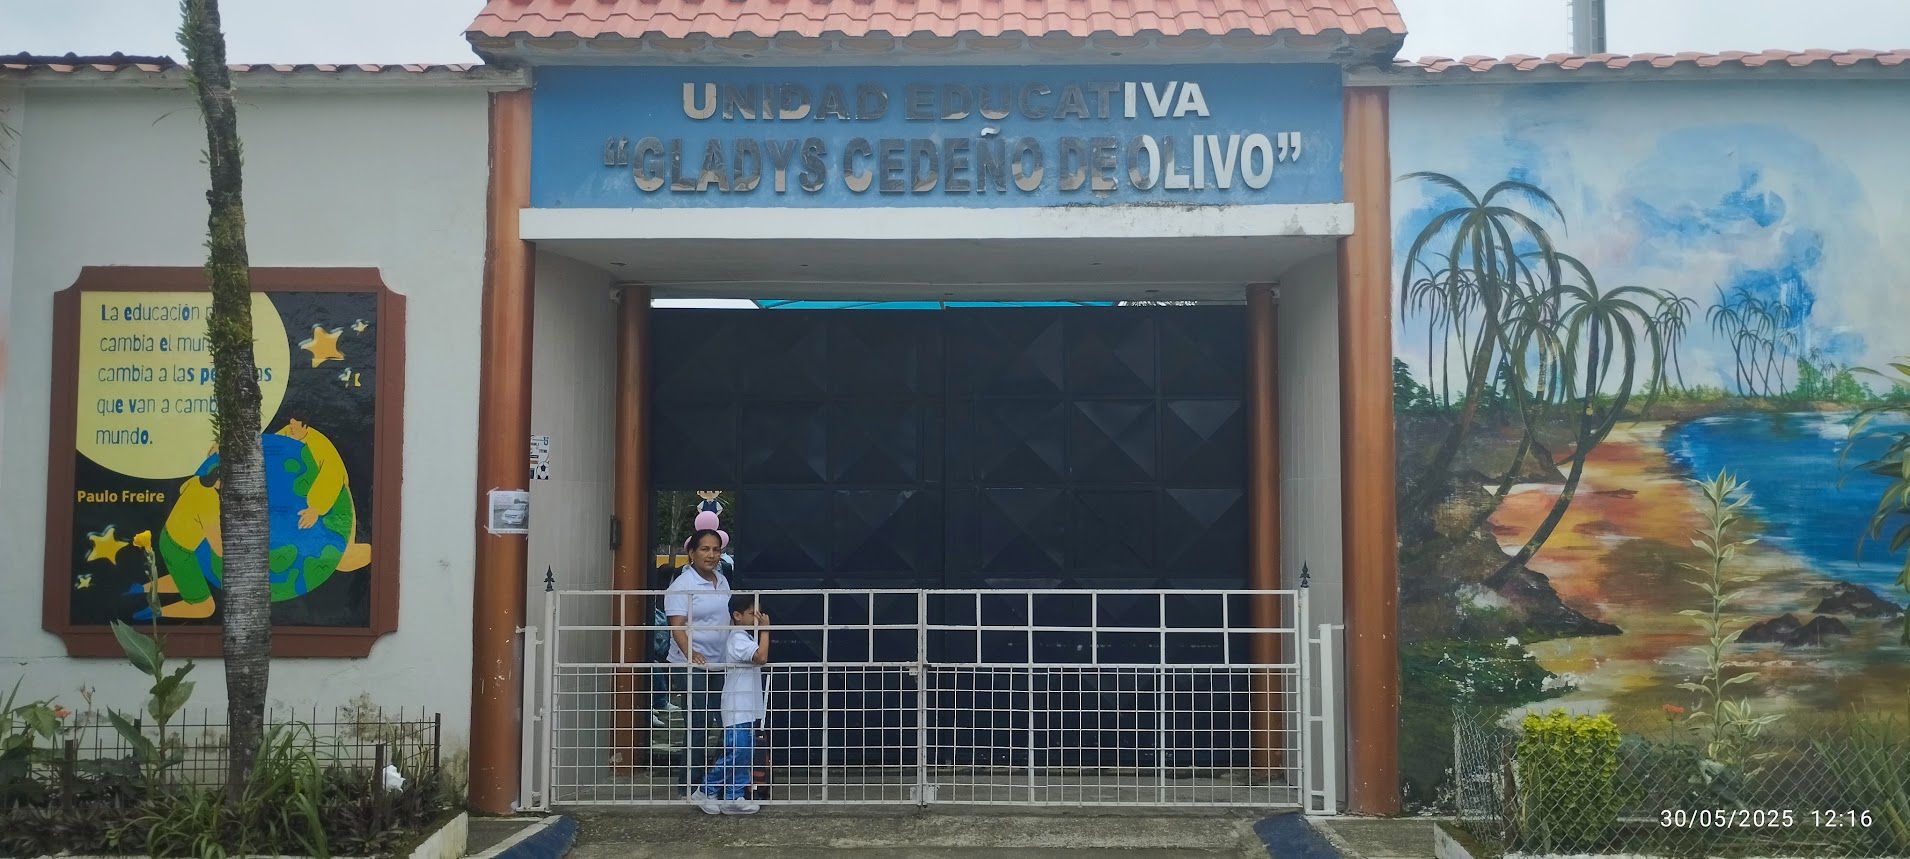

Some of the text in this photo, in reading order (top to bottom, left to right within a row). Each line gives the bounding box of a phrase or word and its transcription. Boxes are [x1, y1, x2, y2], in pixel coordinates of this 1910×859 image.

[682, 80, 1210, 121] UNIDAD EDUCATIVA
[843, 126, 1045, 192] CEDEÑO
[1058, 134, 1118, 192] DE
[101, 303, 119, 321] La
[124, 303, 200, 321] educación
[100, 334, 154, 352] cambia
[159, 335, 172, 352] el
[98, 364, 153, 382] cambia
[158, 367, 167, 382] a
[173, 364, 194, 382] las
[97, 398, 123, 416] que
[128, 398, 156, 414] van
[161, 398, 170, 414] a
[96, 427, 153, 445] mundo.
[77, 489, 165, 503] Paulo Freire
